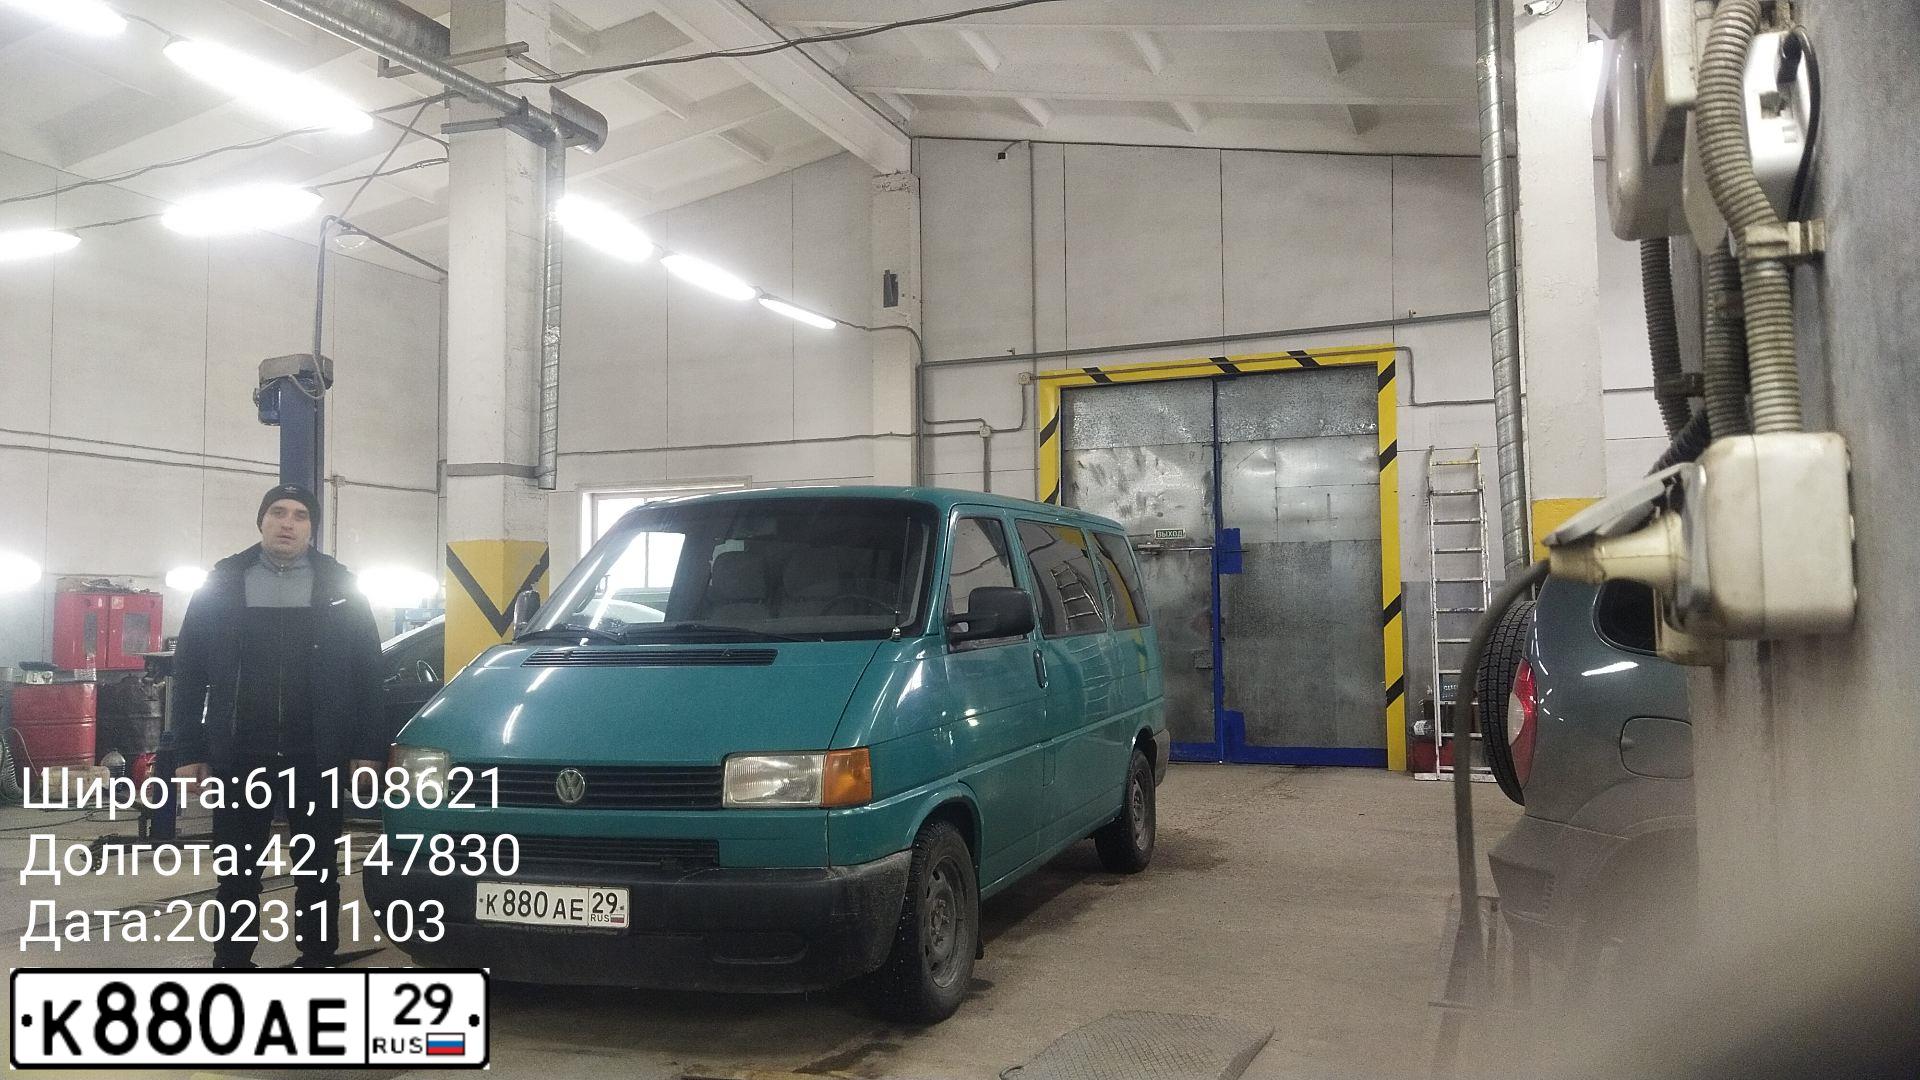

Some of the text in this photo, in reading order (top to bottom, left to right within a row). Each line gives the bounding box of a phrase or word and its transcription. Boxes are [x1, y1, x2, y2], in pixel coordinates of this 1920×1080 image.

[1157, 530, 1184, 538] ВЫХОД
[592, 891, 618, 914] 29
[590, 914, 610, 923] RUS
